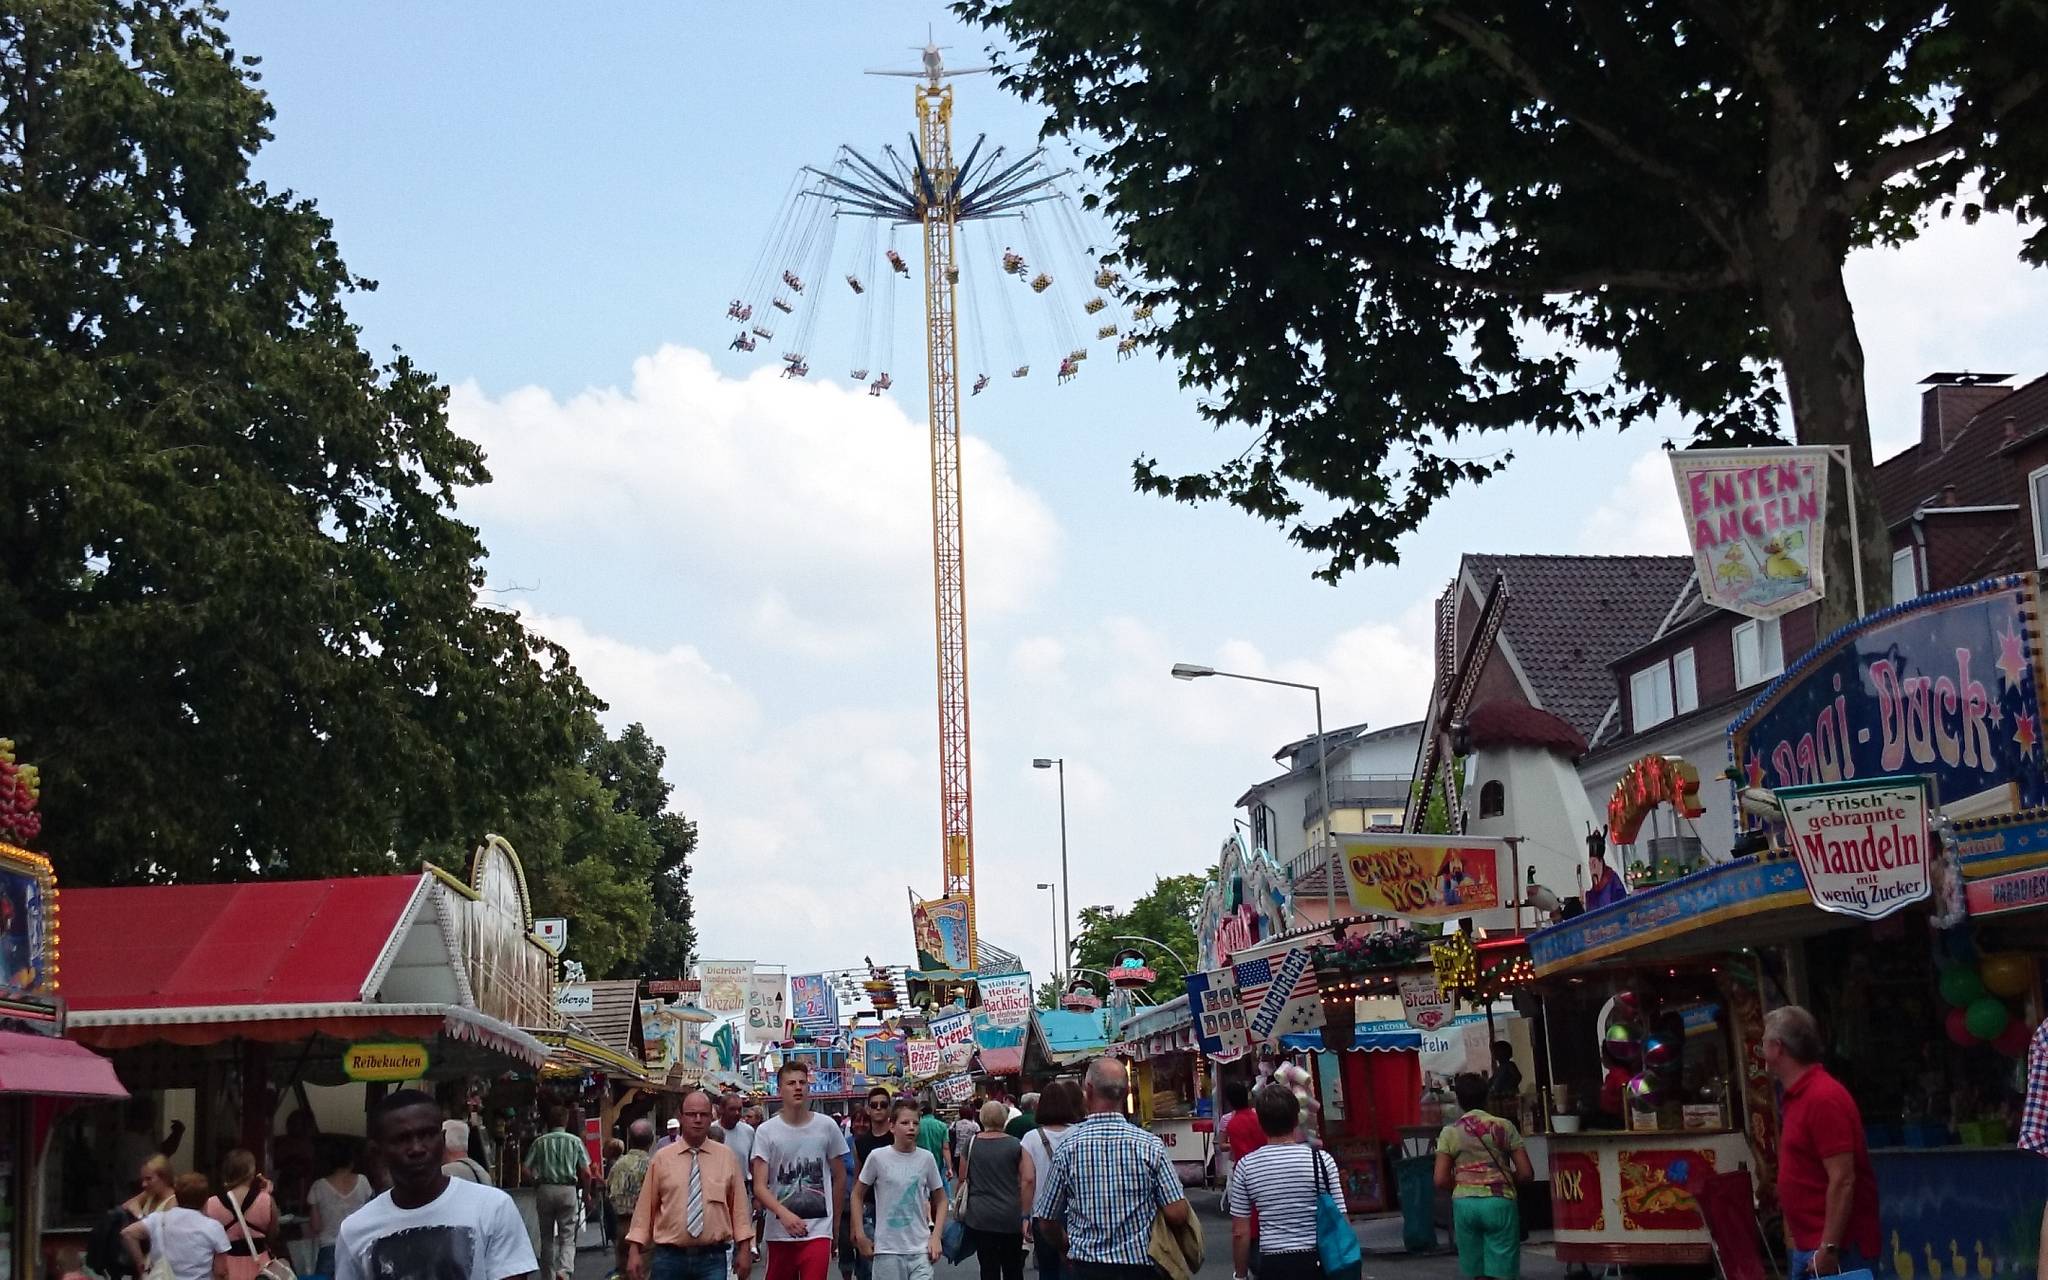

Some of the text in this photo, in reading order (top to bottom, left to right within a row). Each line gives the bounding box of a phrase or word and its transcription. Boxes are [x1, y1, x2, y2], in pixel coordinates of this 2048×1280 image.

[1688, 460, 1811, 515] ENTEN-
[1696, 491, 1818, 550] ANGELN
[1826, 794, 1883, 812] Frisch
[1808, 807, 1906, 831] gebrannte
[1803, 824, 1919, 874] Mandeln
[1856, 874, 1879, 885] mit
[1993, 875, 2048, 903] PARADIES
[1822, 881, 1921, 909] wenig Zucker
[792, 977, 806, 991] 10
[988, 986, 1022, 997] Heißer
[1250, 947, 1310, 1039] HAMBURGER
[983, 995, 1029, 1013] Backfisch
[748, 1007, 783, 1028] Eis
[1203, 1008, 1245, 1036] DOG
[936, 1023, 973, 1051] Crêpes
[1420, 1037, 1449, 1053] feln
[353, 1054, 421, 1069] Reibekuchen
[911, 1051, 938, 1064] BRAT-
[911, 1060, 938, 1072] WURST
